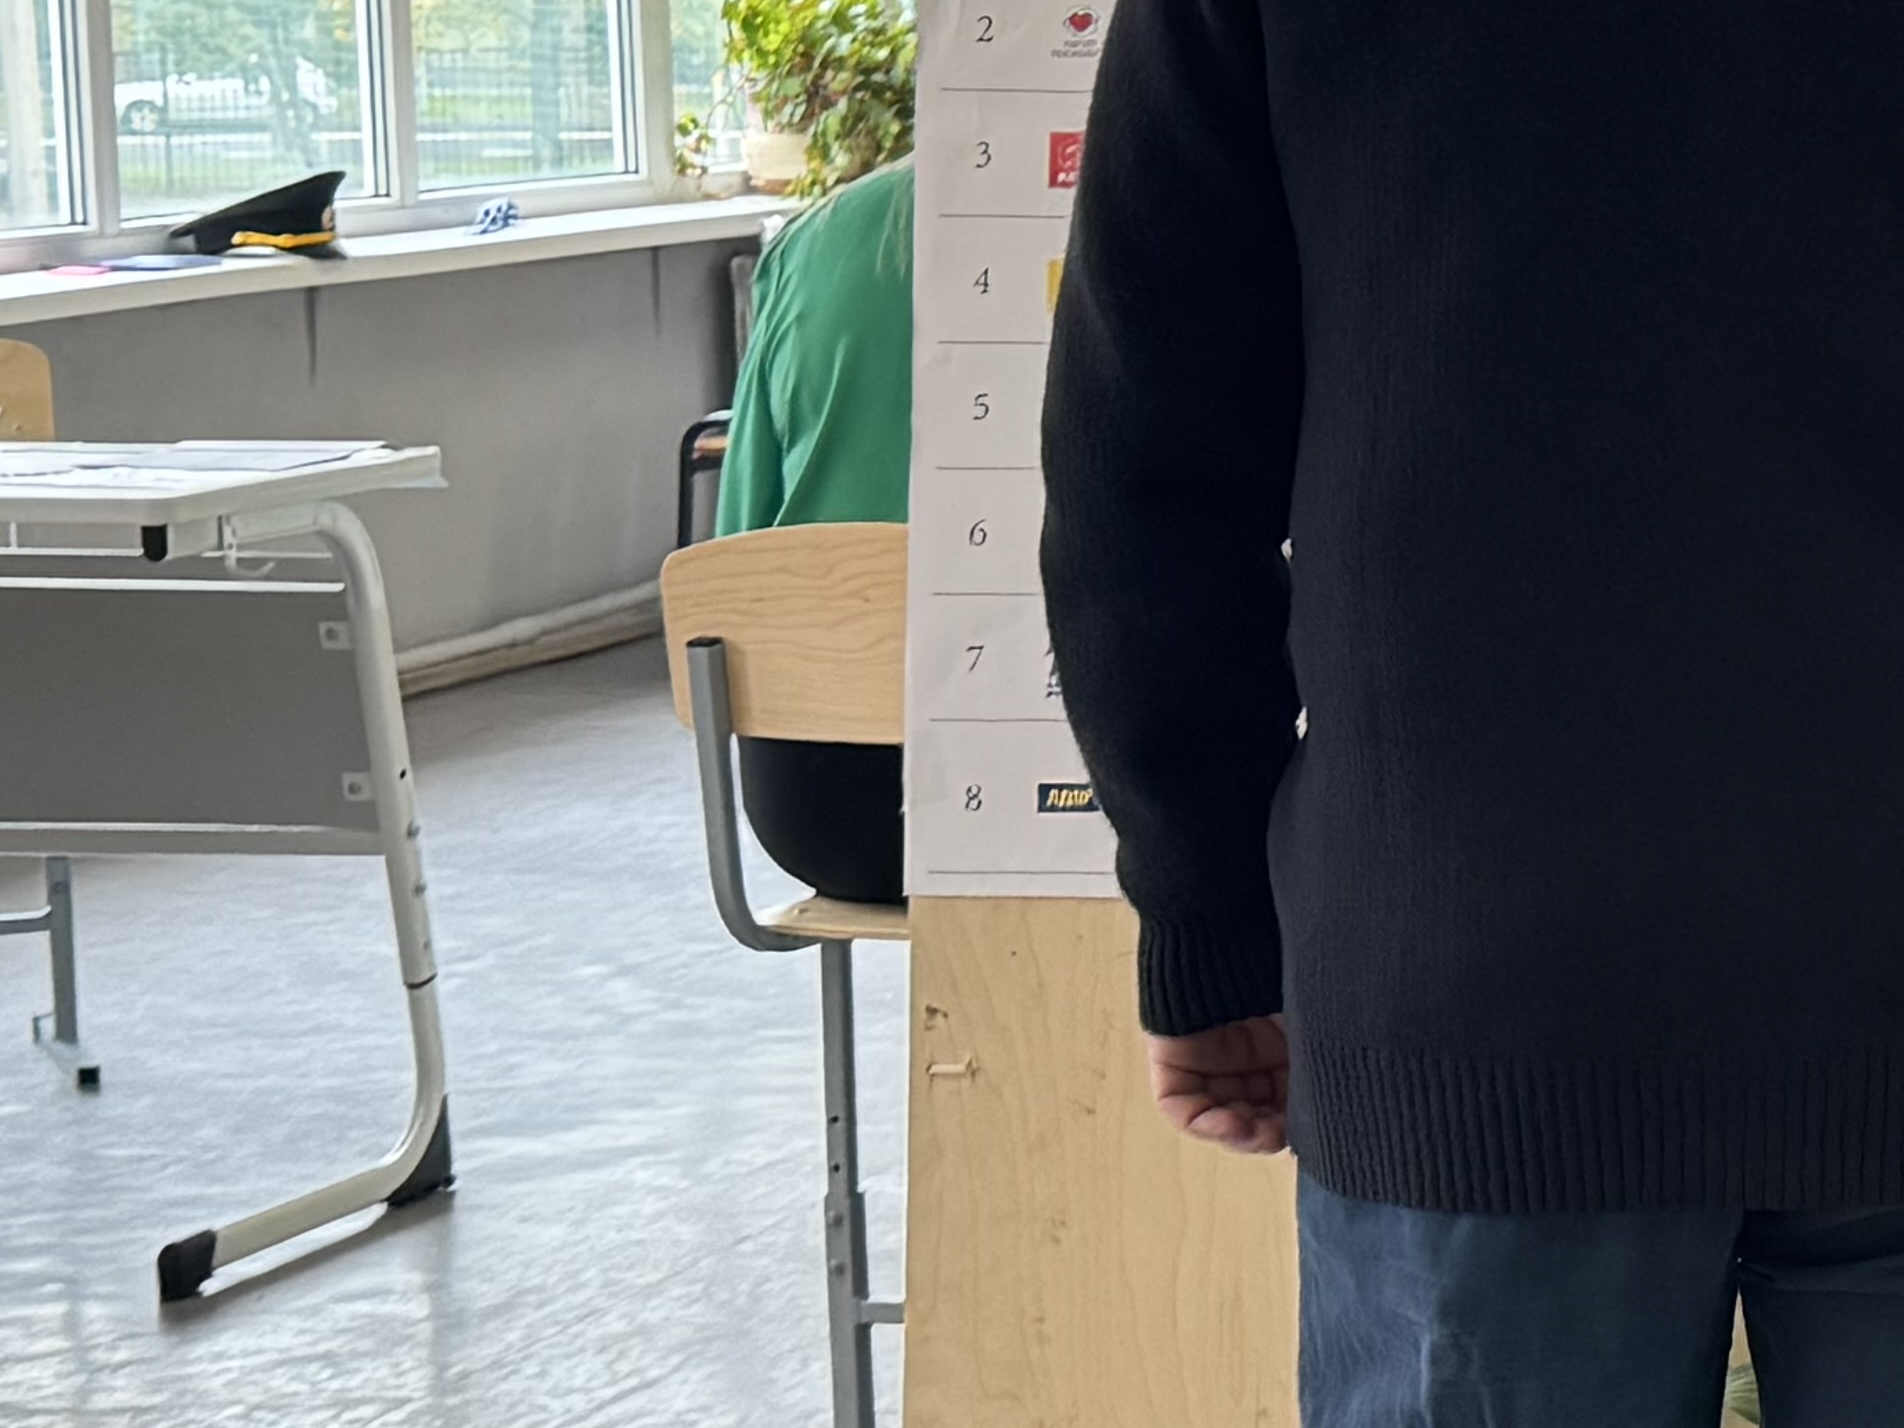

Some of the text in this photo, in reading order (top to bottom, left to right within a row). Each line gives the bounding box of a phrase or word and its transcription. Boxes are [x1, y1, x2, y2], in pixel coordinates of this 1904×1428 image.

[976, 15, 994, 42] 2
[976, 141, 992, 168] 3
[973, 267, 990, 294] 4
[972, 393, 990, 420] 5
[968, 519, 987, 545] 6
[966, 645, 984, 671] 7
[965, 785, 982, 811] 8
